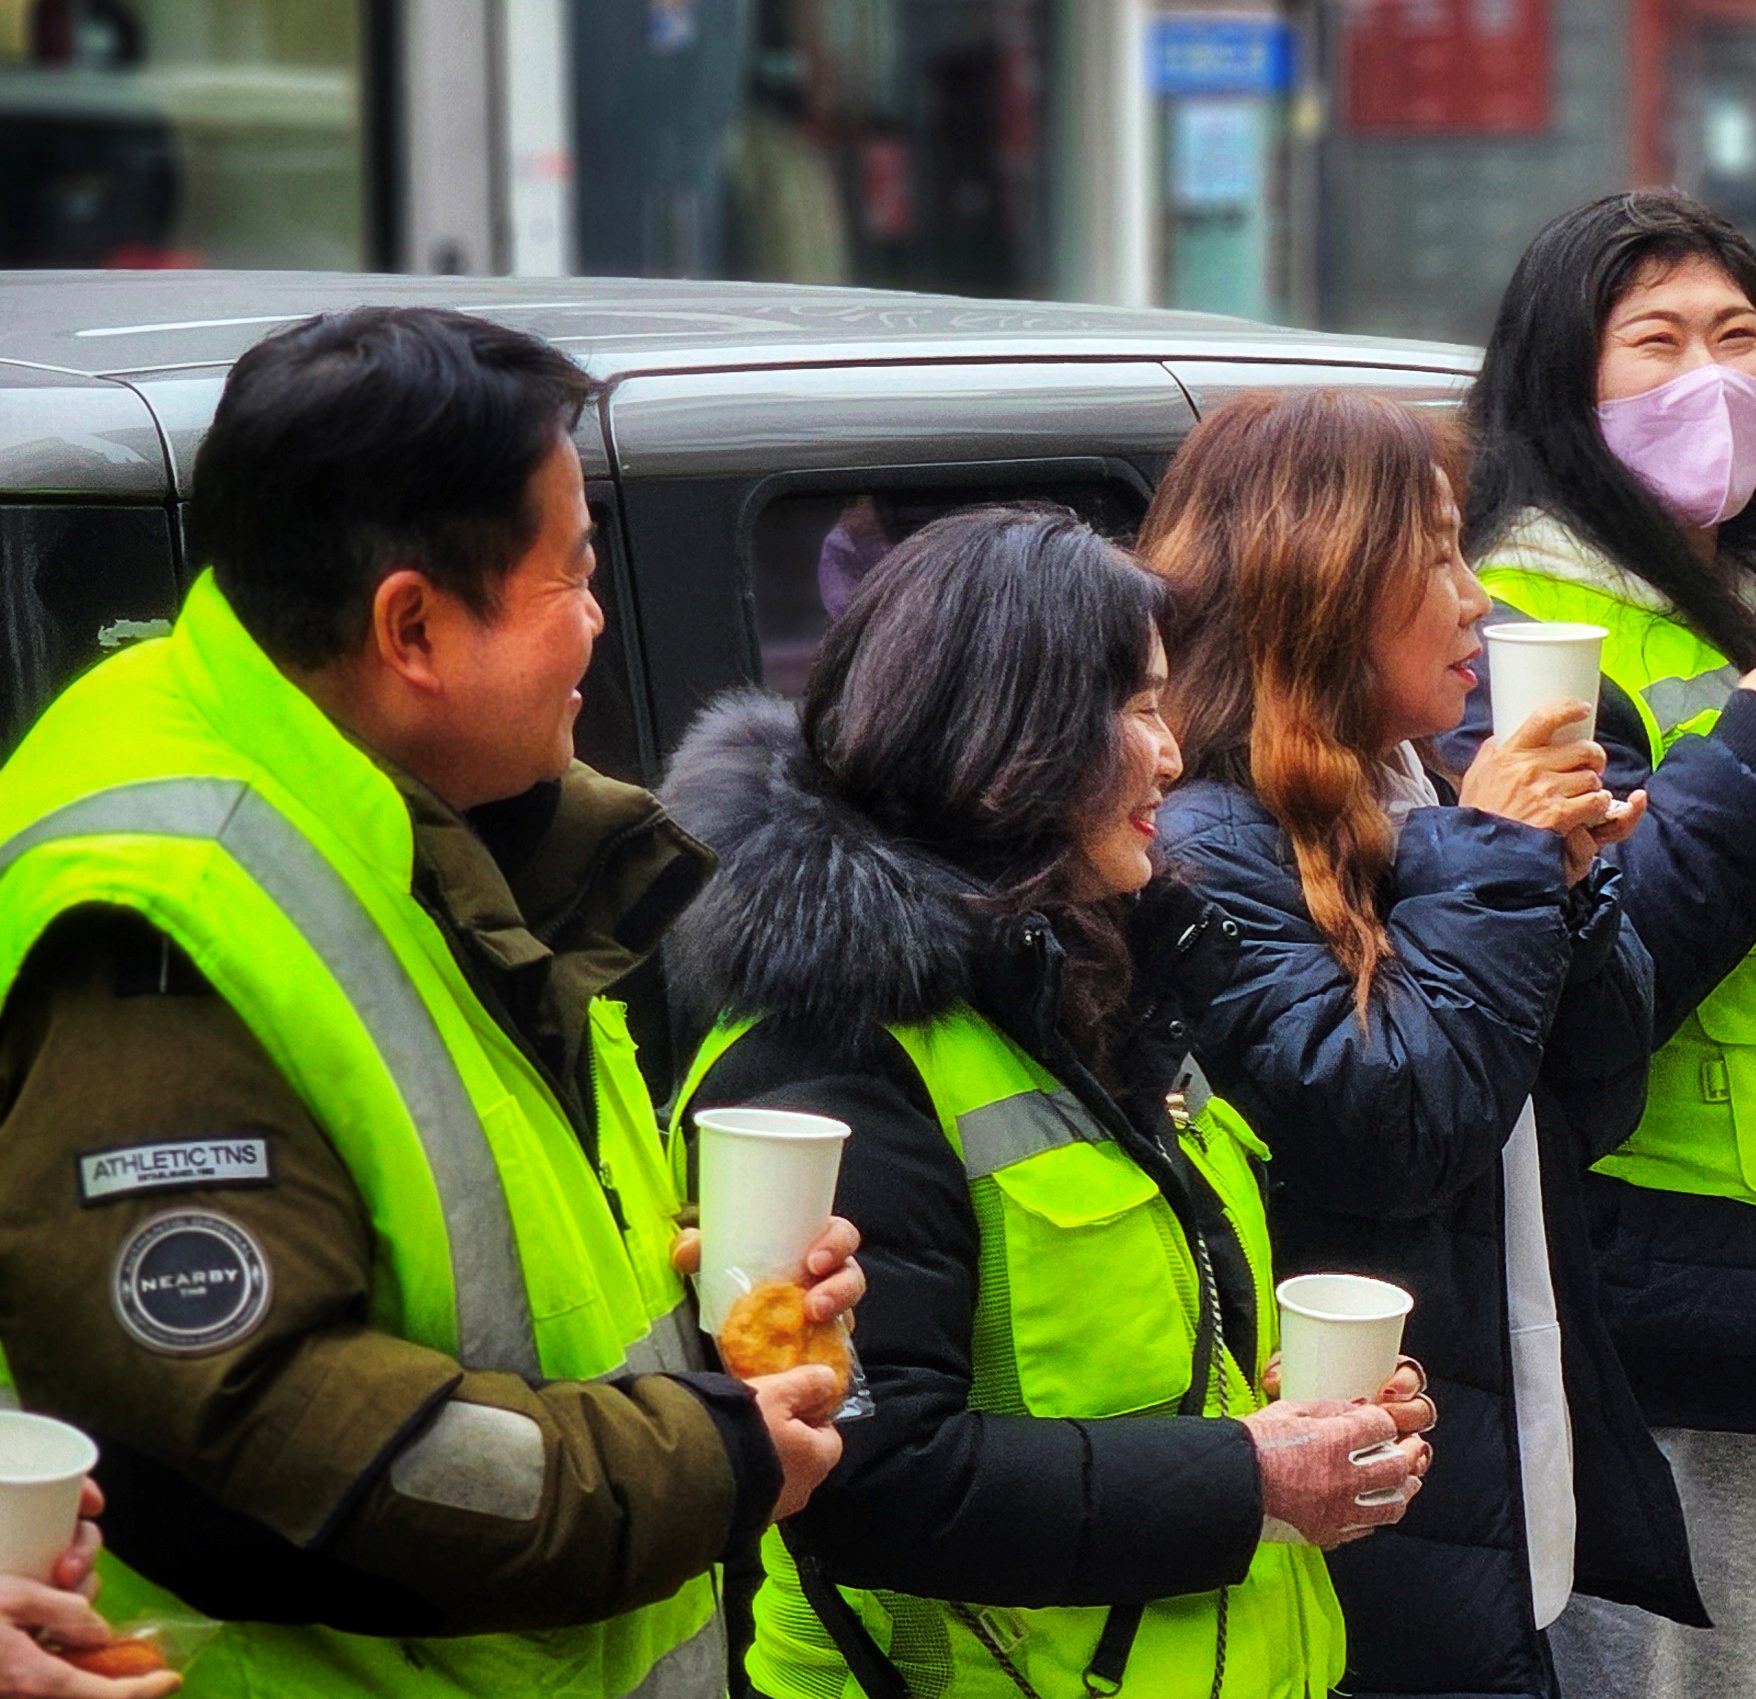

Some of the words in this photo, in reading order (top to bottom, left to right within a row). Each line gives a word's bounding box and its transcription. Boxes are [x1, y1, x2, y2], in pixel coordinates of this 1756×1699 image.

[93, 1147, 207, 1180] ATHLETIC
[210, 1144, 257, 1165] TNS
[140, 1268, 238, 1293] NEARBY
